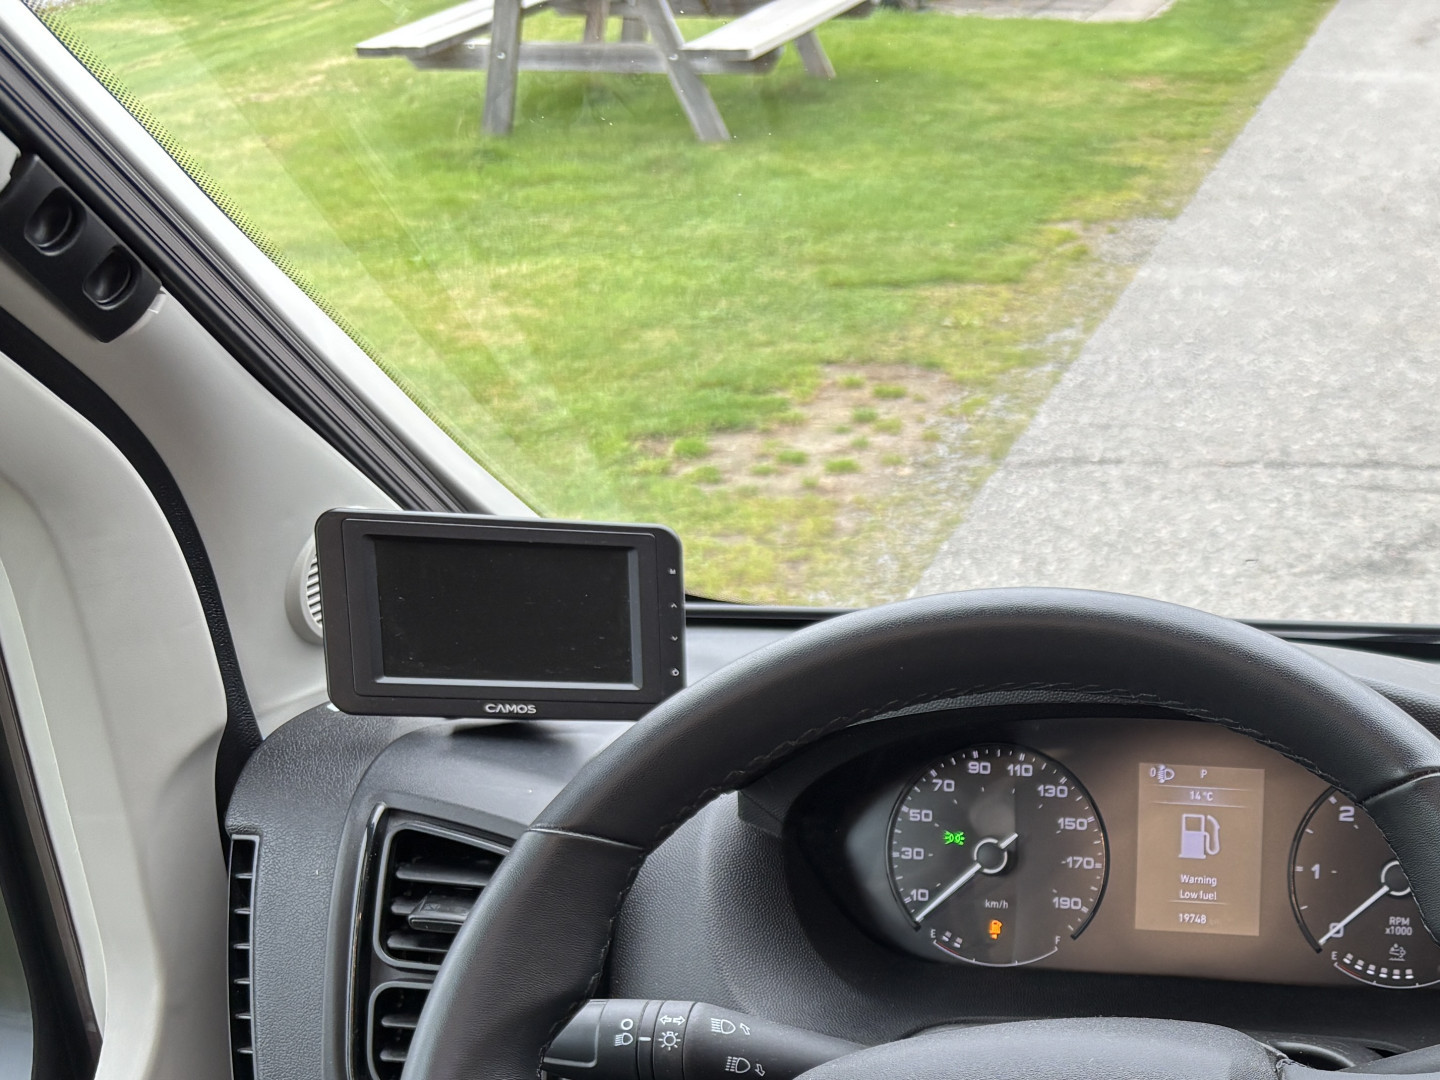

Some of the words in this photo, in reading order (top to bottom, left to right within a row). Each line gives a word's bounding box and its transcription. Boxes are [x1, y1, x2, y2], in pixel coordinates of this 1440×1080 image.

[485, 703, 537, 715] CAMOS
[968, 762, 991, 774] 90
[1007, 764, 1033, 777] 110
[1200, 769, 1207, 779] P
[932, 779, 955, 792] 70
[1037, 785, 1068, 798] 130
[909, 810, 933, 822] 50
[1338, 806, 1355, 822] 2
[1057, 818, 1088, 830] 150
[901, 848, 924, 860] 30
[1066, 857, 1095, 869] 170
[1311, 864, 1320, 880] 1
[1180, 874, 1218, 887] Warning
[910, 889, 929, 901] 10
[1179, 890, 1198, 899] Low
[1199, 890, 1217, 900] fuel
[985, 899, 1009, 910] km/h
[1053, 898, 1081, 909] 190
[1178, 913, 1207, 924] 19748
[1389, 917, 1410, 926] RPM
[930, 929, 936, 939] E
[1385, 926, 1413, 936] x1000
[1055, 936, 1060, 945] F
[1331, 951, 1338, 960] E
